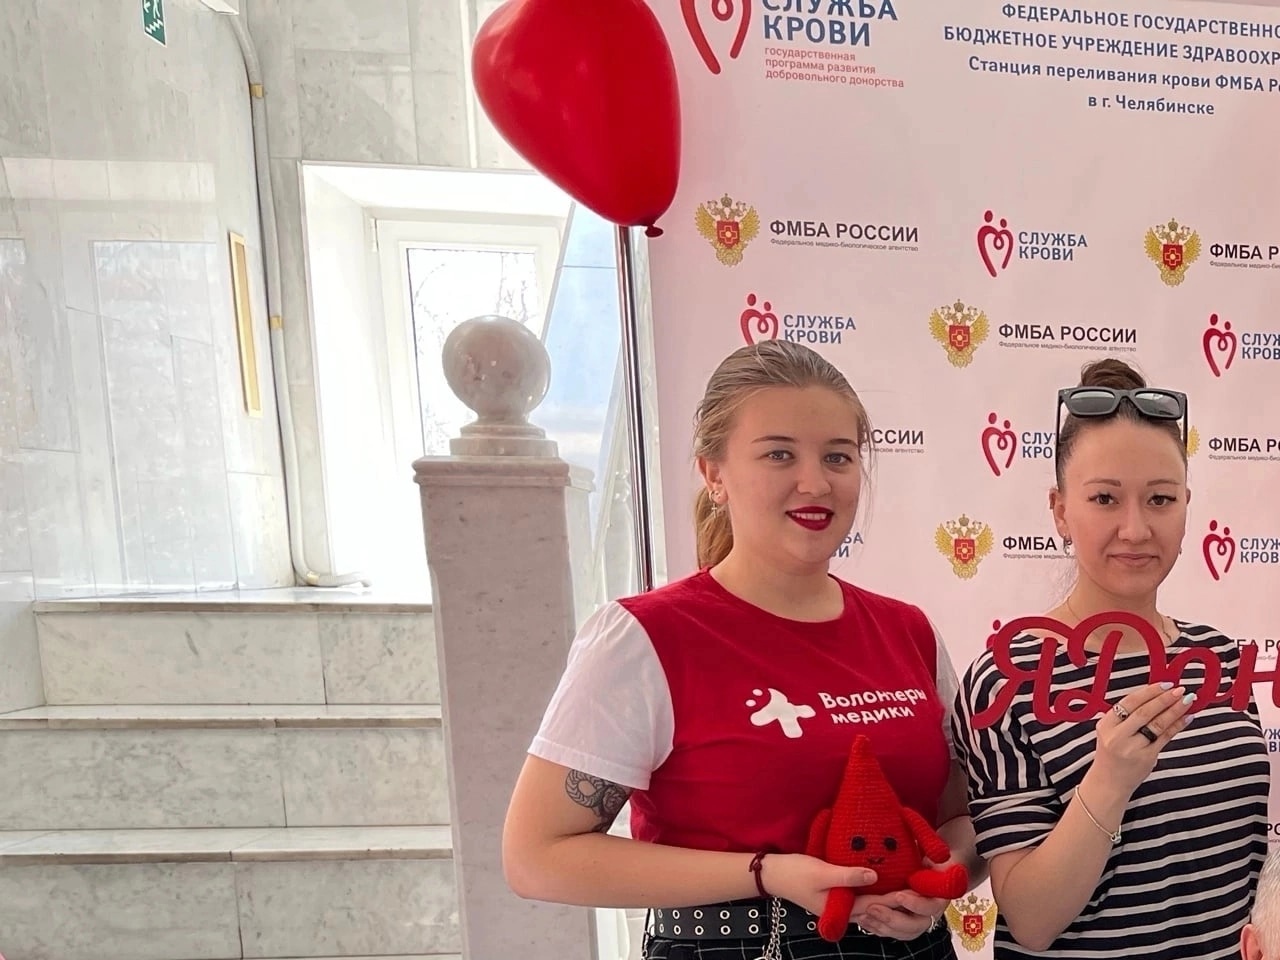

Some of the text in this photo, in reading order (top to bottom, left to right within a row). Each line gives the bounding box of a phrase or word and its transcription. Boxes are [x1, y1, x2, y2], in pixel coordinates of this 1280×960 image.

[1002, 3, 1129, 27] ФЕДЕРАЛЬНОЕ
[763, 14, 870, 47] КРОВИ
[944, 26, 1057, 49] БЮДЖЕТНОЕ
[1062, 35, 1178, 58] УЧРЕЖДЕНИЕ
[764, 47, 856, 61] государственная
[765, 58, 876, 74] программа развития
[969, 56, 1041, 76] Станция
[1046, 65, 1157, 84] переливания
[1162, 72, 1210, 89] крови
[1215, 74, 1264, 92] ФМБА
[765, 70, 904, 88] добровольного донорства
[1088, 95, 1214, 115] в г. Челябинске
[770, 220, 918, 242] ФМБА РОССИИ
[1019, 231, 1088, 247] СЛУЖБА
[771, 238, 814, 247] Федеральное
[1019, 246, 1073, 261] КРОВИ
[1210, 243, 1262, 260] ФМБА
[784, 314, 856, 330] СЛУЖБА
[784, 329, 842, 344] КРОВИ
[999, 323, 1137, 343] ФМБА РОССИИ
[871, 429, 924, 445] ССИИ
[1022, 432, 1053, 445] СЛУ
[1209, 437, 1261, 453] ФМБА
[1022, 446, 1053, 459] КРО
[1003, 536, 1058, 551] ФМБА
[830, 706, 915, 724] медики
